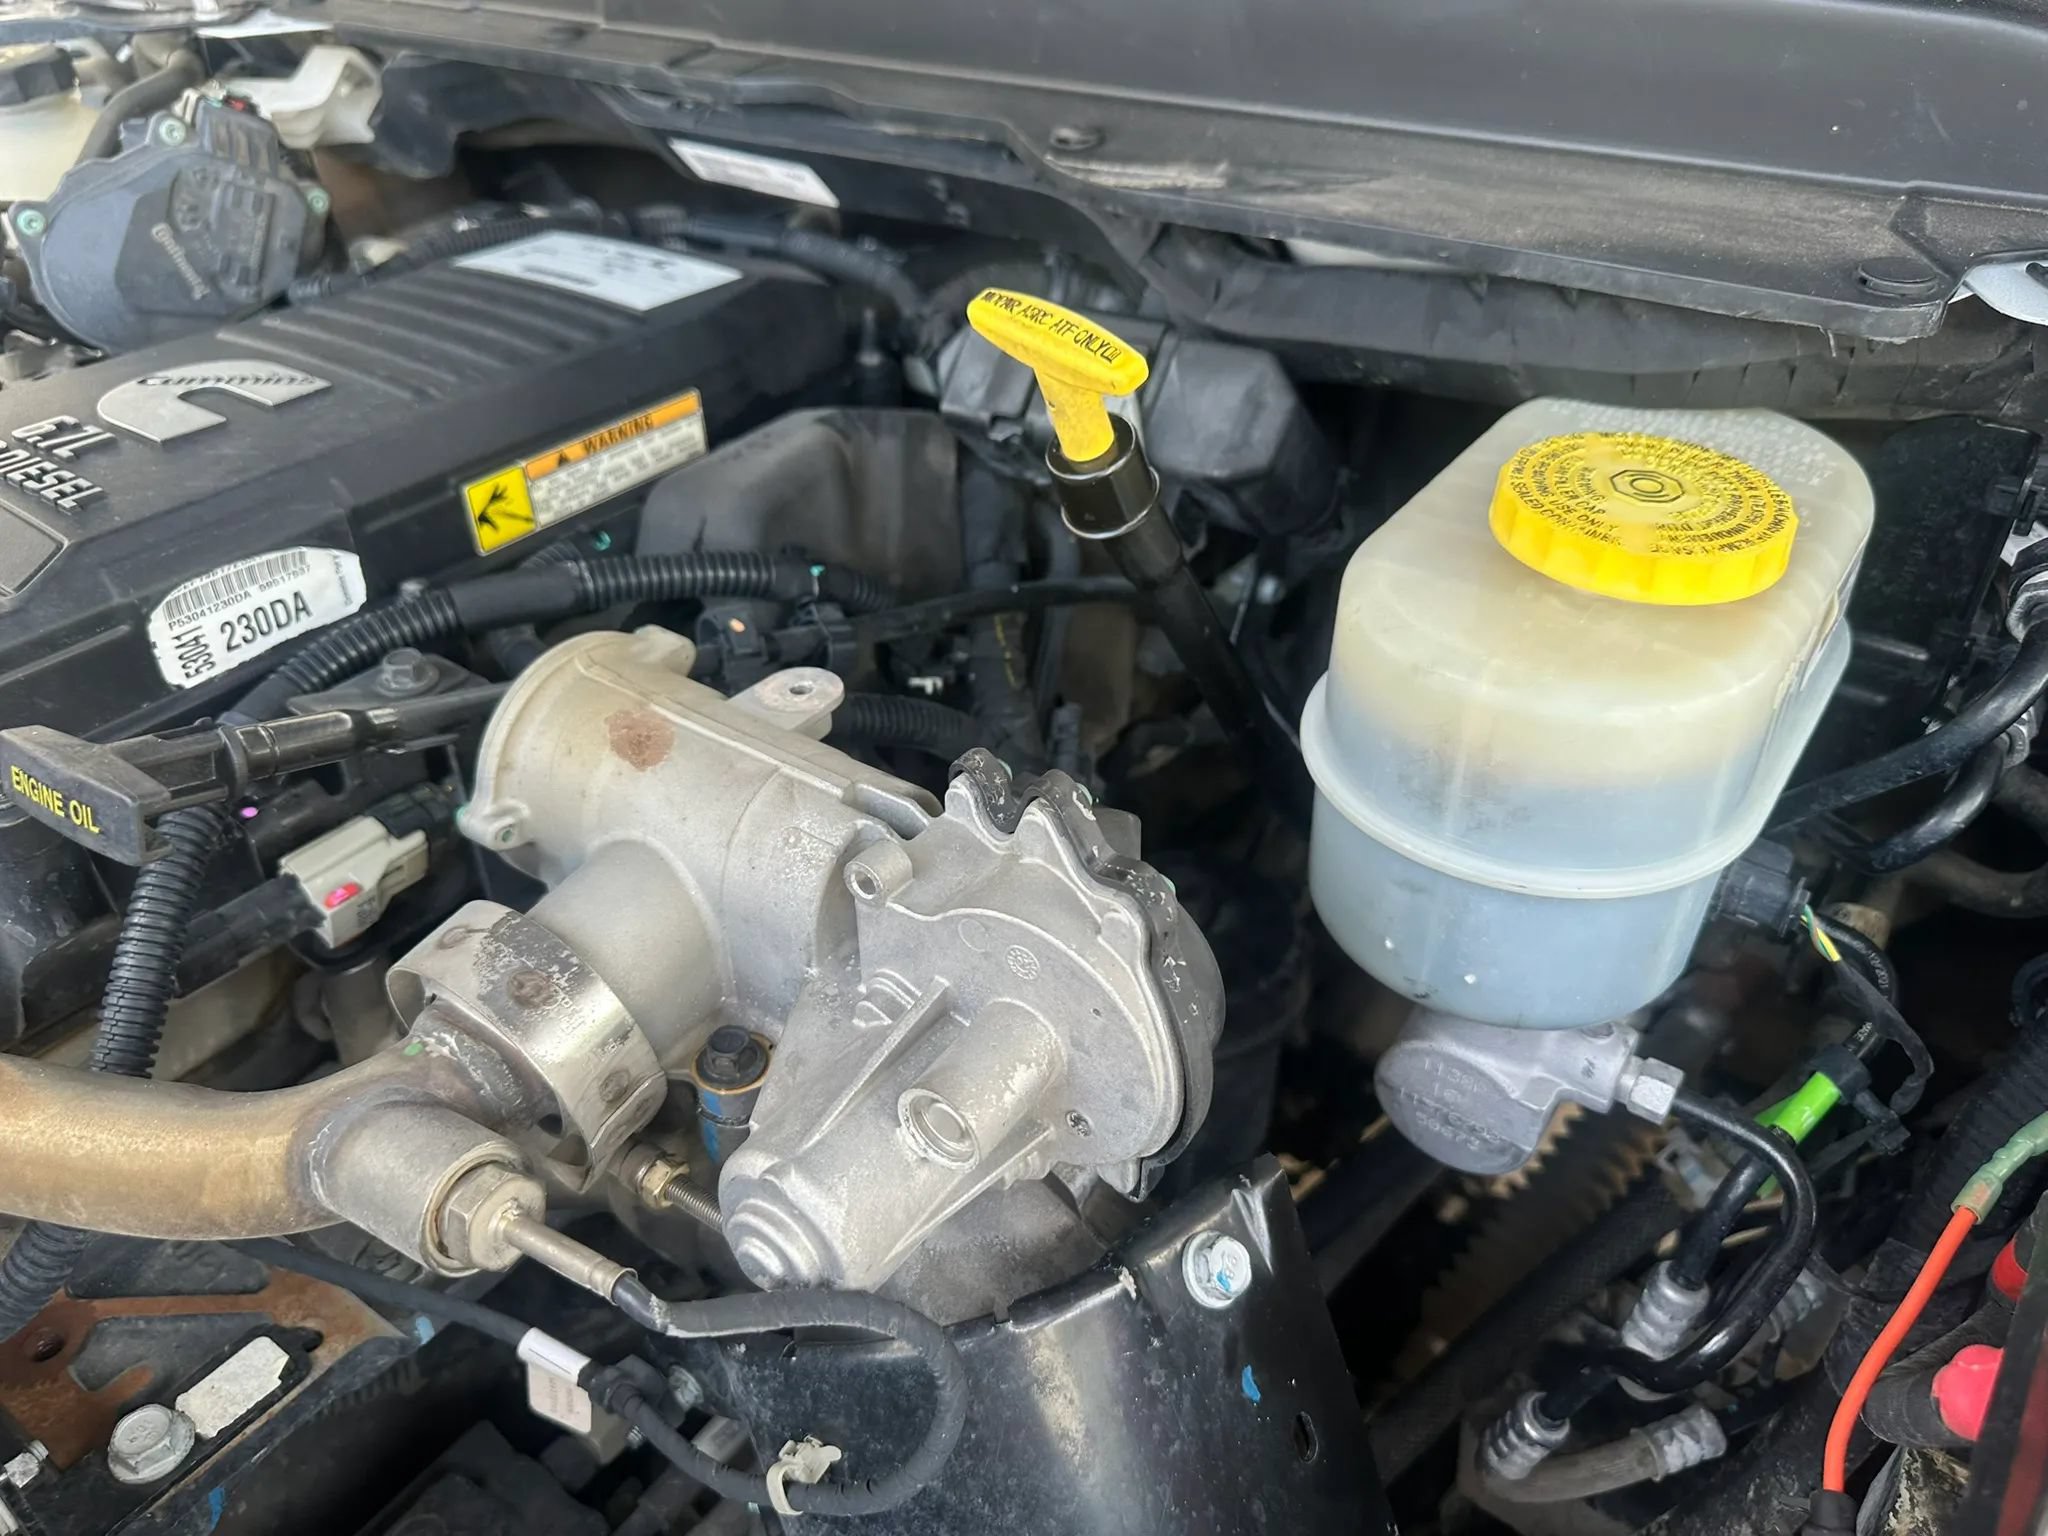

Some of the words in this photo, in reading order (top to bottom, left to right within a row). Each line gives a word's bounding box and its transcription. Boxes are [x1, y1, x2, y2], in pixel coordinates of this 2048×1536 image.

[1050, 318, 1079, 337] ATF
[1549, 500, 1577, 515] USE
[1575, 501, 1606, 515] CAP
[168, 591, 253, 631] P53041230DA
[219, 590, 312, 653] 230DA
[171, 625, 217, 680] 53041
[11, 765, 65, 818] ENGINE
[69, 799, 101, 834] OIL
